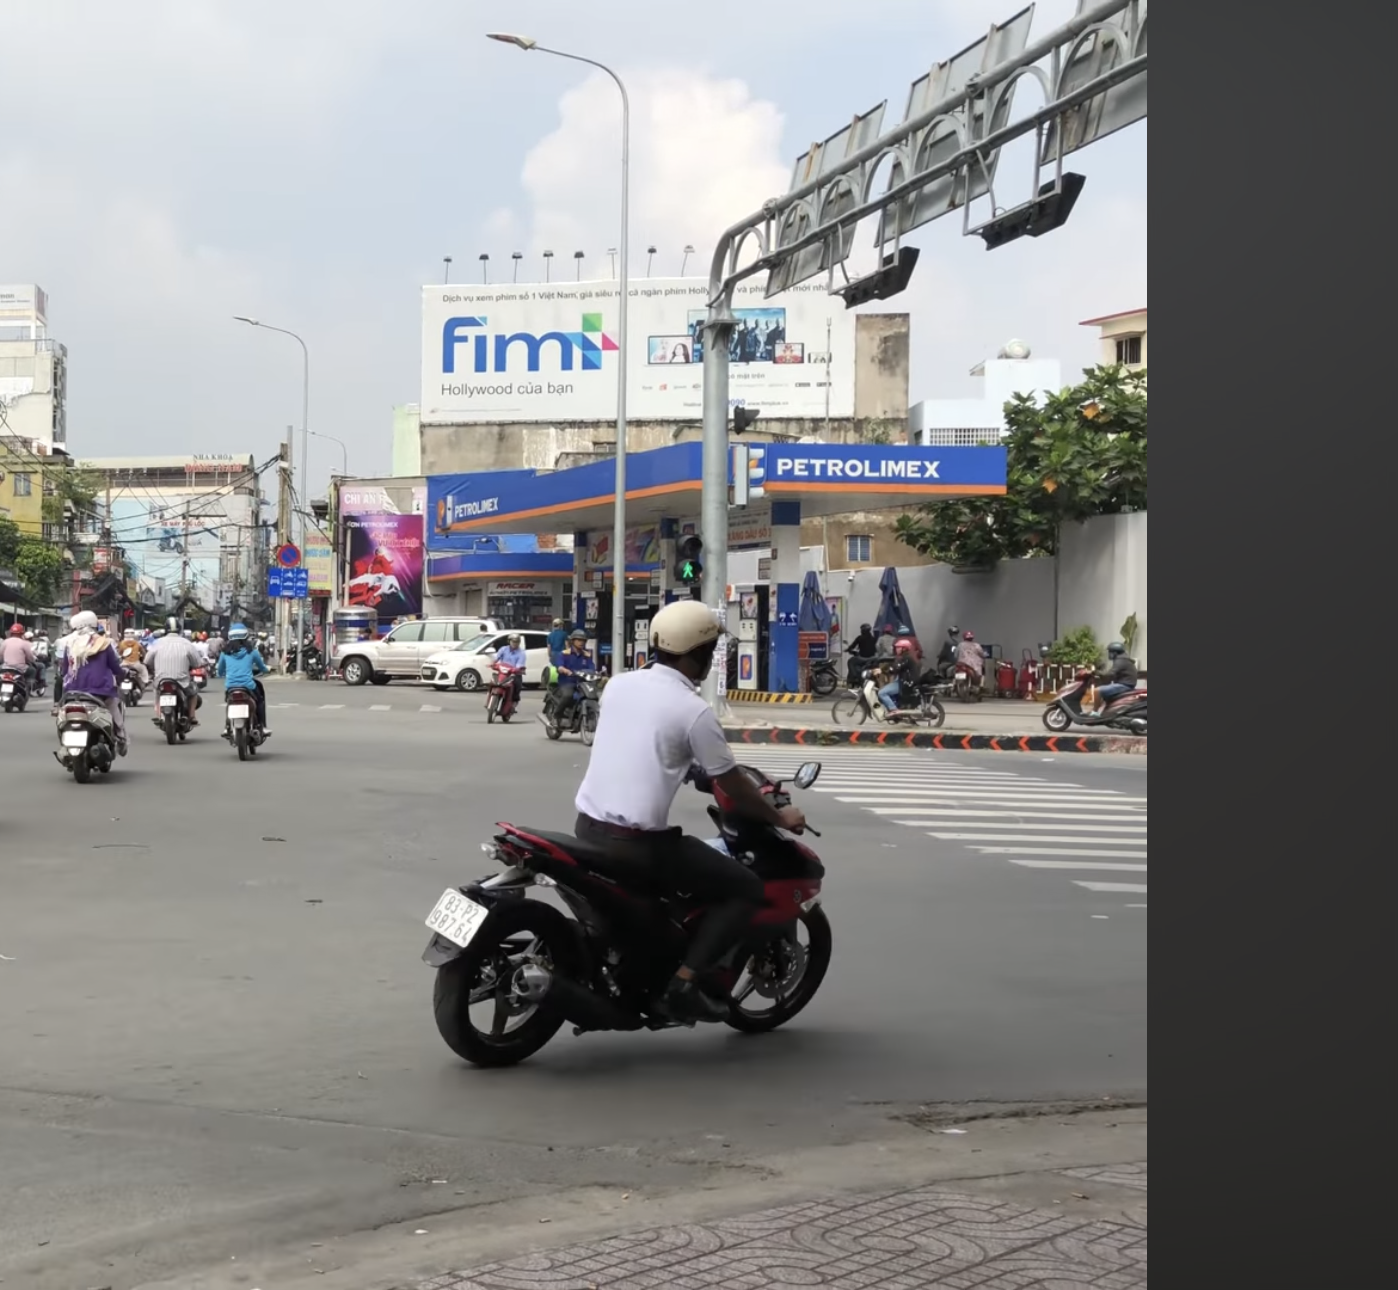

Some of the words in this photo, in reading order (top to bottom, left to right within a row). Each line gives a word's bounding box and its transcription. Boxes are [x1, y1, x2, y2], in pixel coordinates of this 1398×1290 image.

[442, 294, 461, 303] Dịch
[463, 295, 474, 303] vụ
[496, 293, 517, 302] phim
[539, 292, 555, 300] Việt
[580, 291, 593, 301] giá
[595, 289, 612, 298] siêu
[628, 287, 639, 296] cả
[641, 286, 662, 297] ngàn
[664, 286, 687, 297] phim
[737, 285, 748, 293] và
[792, 283, 811, 292] mới
[813, 283, 829, 291] nhấ
[441, 383, 513, 398] Hollywood
[517, 382, 542, 395] của
[547, 381, 574, 396] bạn
[776, 458, 941, 479] PETROLIMEX
[454, 497, 499, 518] PETROLIMEX
[444, 895, 480, 924] 83-P2
